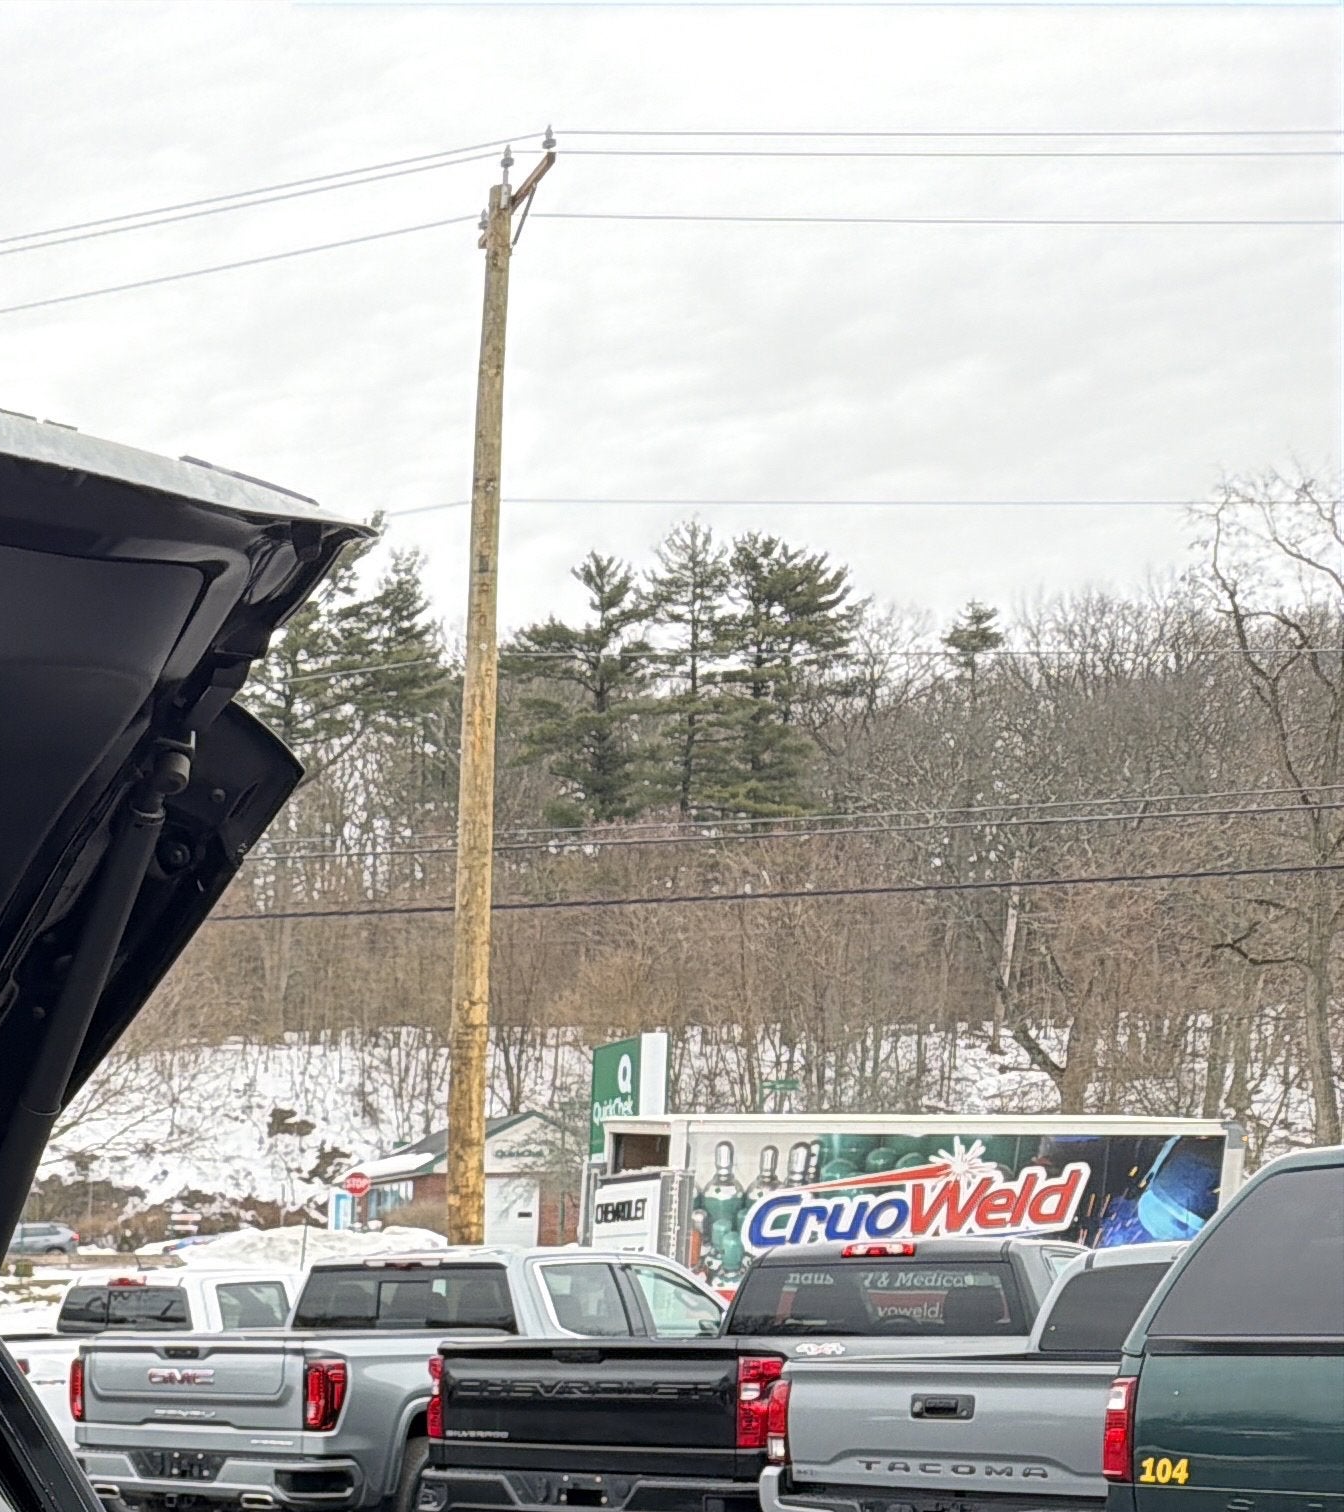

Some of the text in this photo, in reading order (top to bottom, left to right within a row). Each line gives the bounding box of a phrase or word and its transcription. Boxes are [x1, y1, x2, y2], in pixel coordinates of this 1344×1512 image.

[894, 1270, 969, 1287] Medica
[148, 1368, 215, 1385] GMC
[858, 1459, 1049, 1479] TACOMA
[1140, 1457, 1189, 1485] 104
